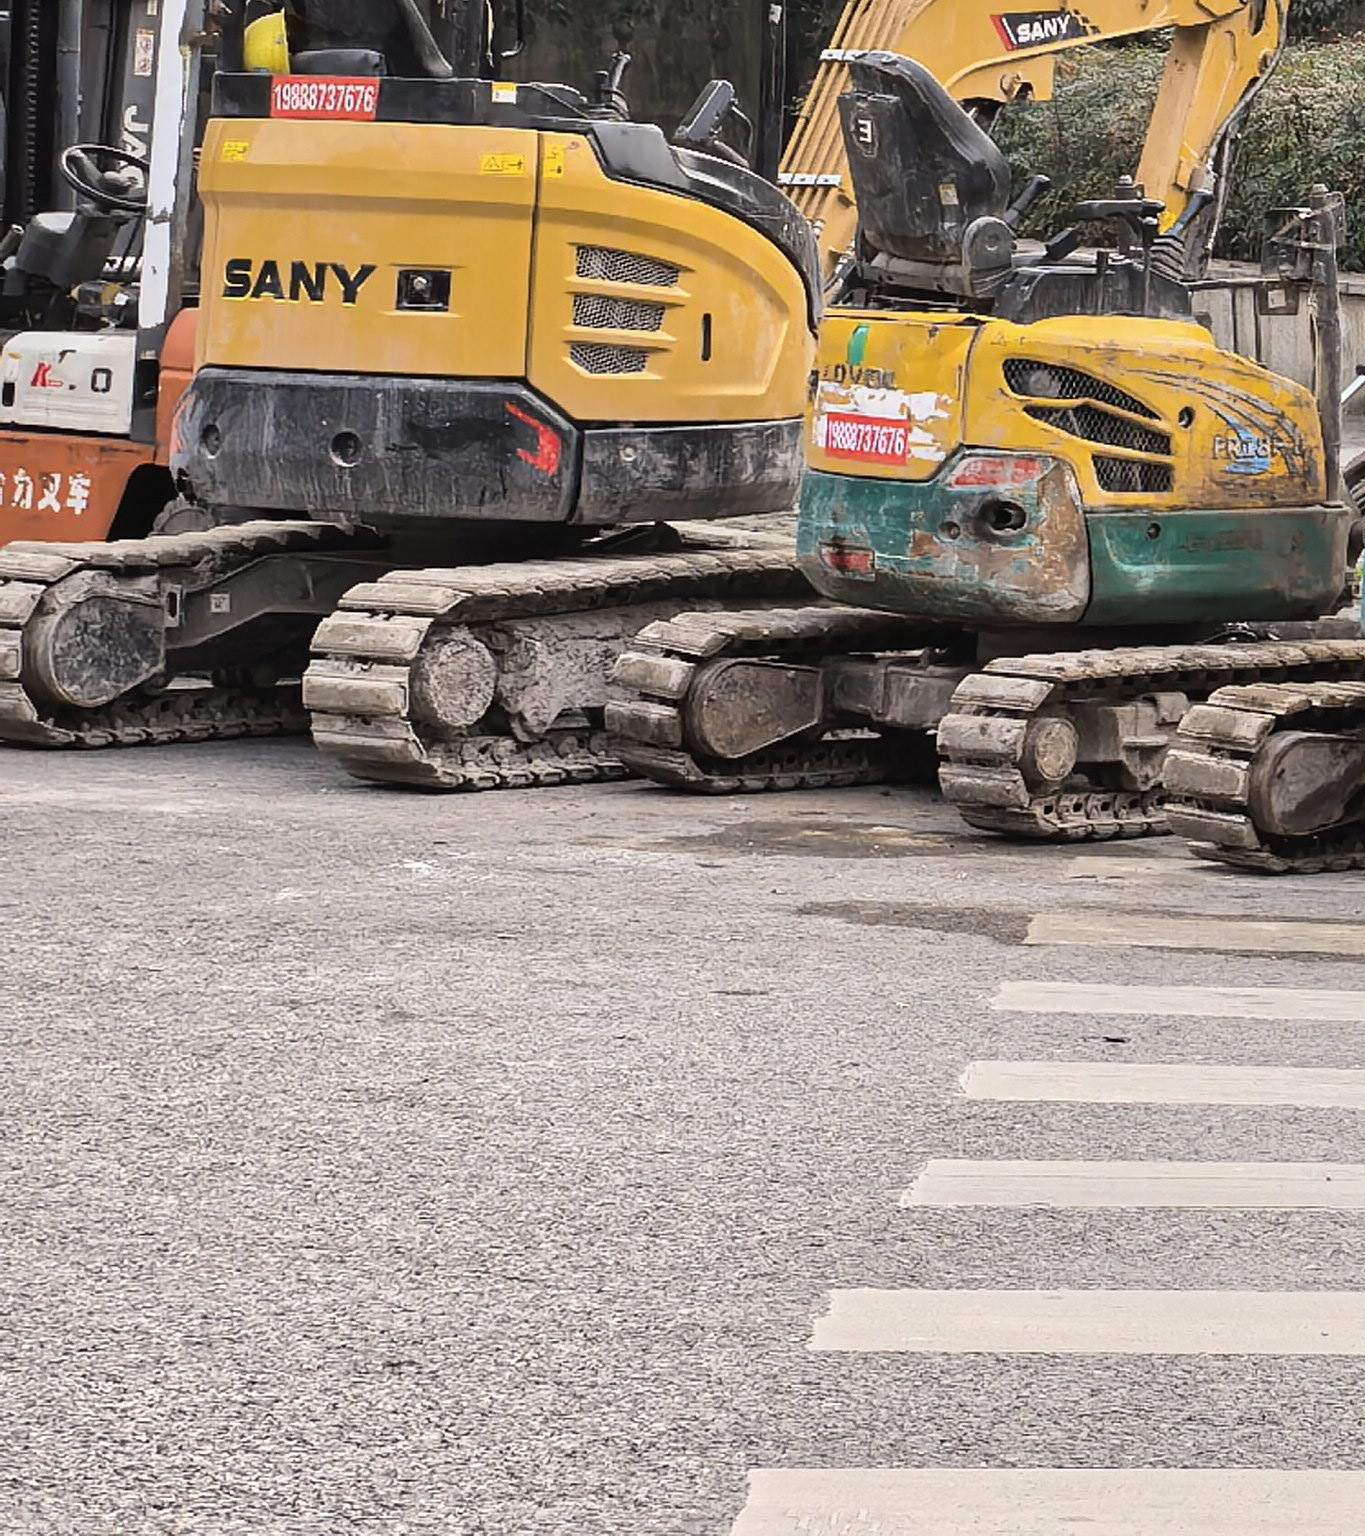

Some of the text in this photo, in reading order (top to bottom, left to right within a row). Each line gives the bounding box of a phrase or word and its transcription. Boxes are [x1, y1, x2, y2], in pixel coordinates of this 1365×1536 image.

[1017, 14, 1070, 43] SANY
[274, 83, 375, 112] 19888737676
[222, 258, 378, 307] SANY
[828, 420, 906, 456] 19888737676
[0, 467, 92, 516] 力叉车
